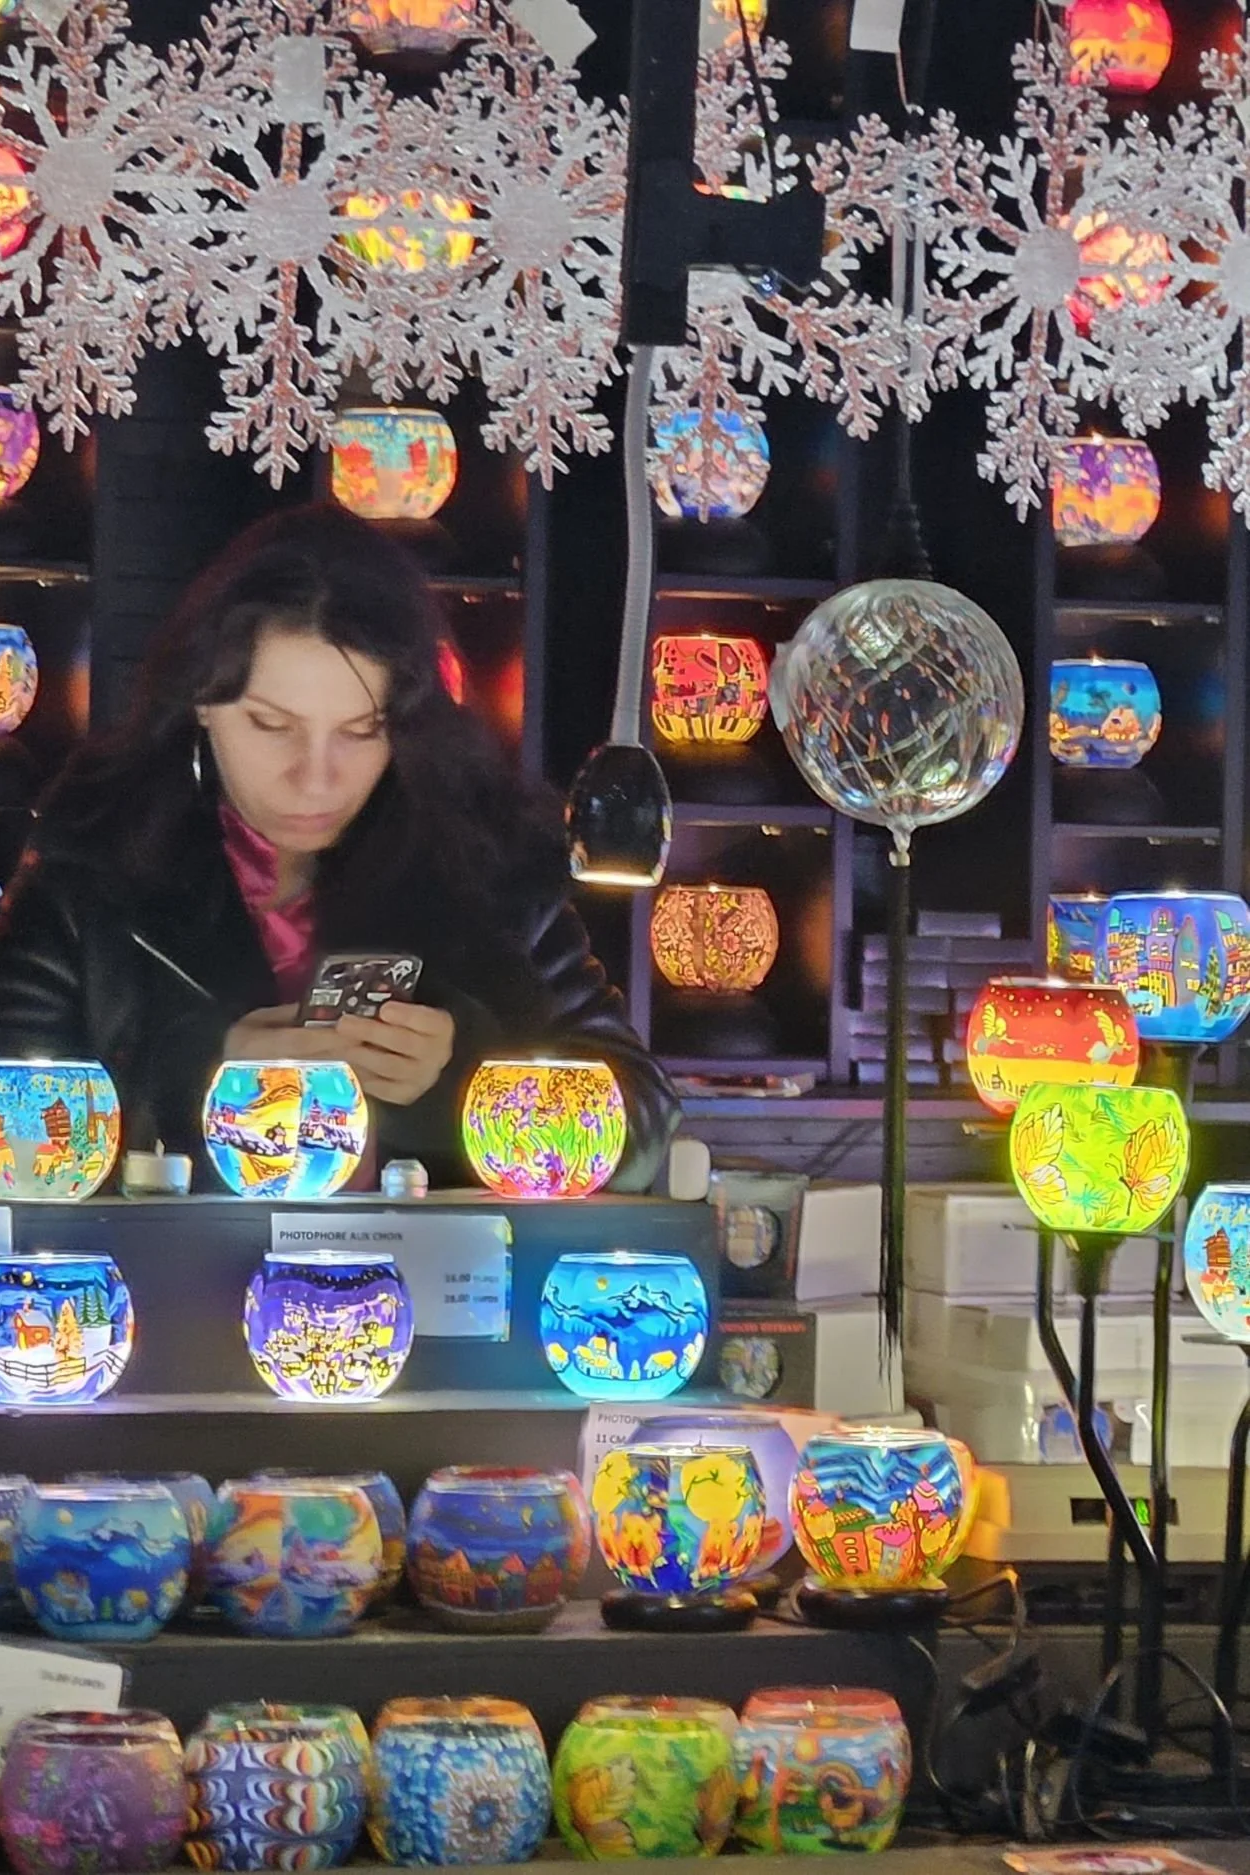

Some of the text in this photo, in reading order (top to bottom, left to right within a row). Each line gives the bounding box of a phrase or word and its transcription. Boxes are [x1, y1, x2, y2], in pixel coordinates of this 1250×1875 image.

[279, 1230, 347, 1240] PHOTOPHORE
[597, 1413, 641, 1425] PHOTOP
[595, 1433, 607, 1444] 11
